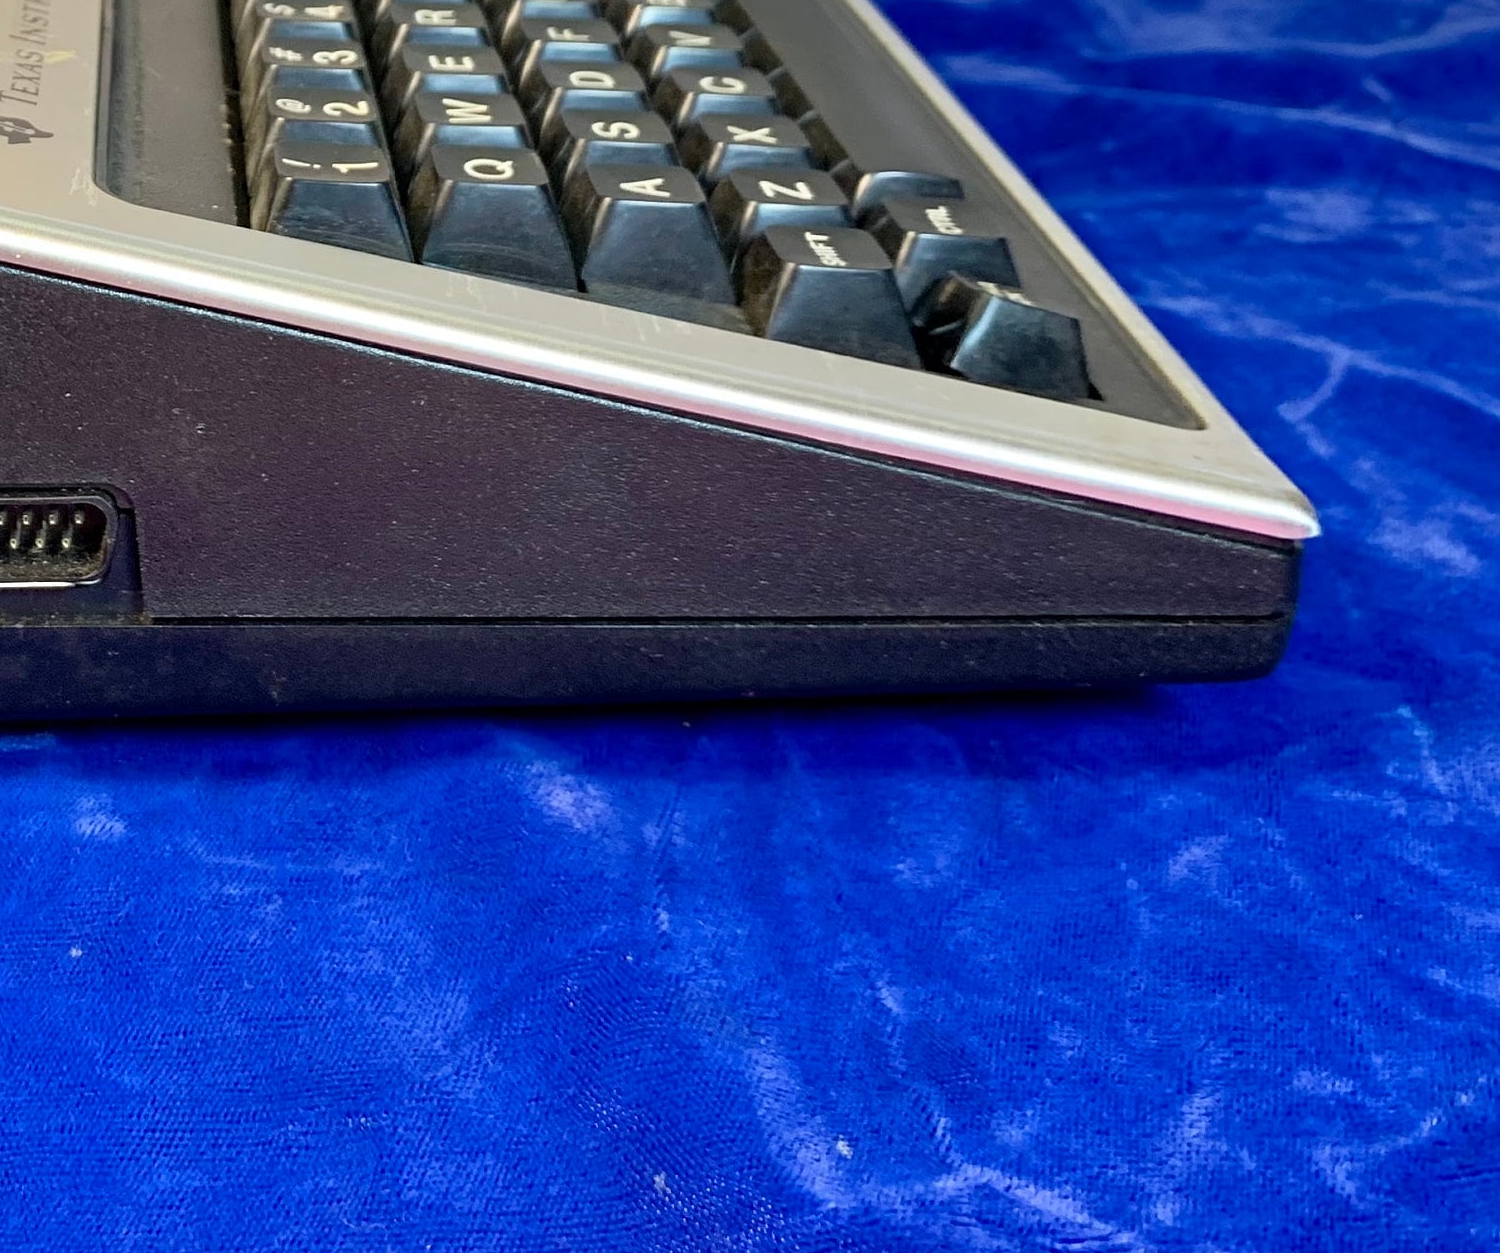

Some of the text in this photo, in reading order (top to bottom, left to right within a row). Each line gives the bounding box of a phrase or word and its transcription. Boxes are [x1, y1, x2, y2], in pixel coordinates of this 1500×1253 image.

[304, 4, 345, 19] 4
[414, 9, 457, 25] R
[547, 26, 590, 41] F
[667, 30, 712, 47] V
[312, 50, 358, 64] 3
[428, 54, 476, 72] E
[568, 70, 617, 89] D
[699, 76, 746, 94] C
[275, 98, 312, 114] @
[322, 100, 369, 116] 2
[442, 98, 492, 124] W
[591, 121, 640, 140] S
[726, 124, 778, 144] X
[282, 157, 322, 169] !
[331, 162, 380, 174] 1
[463, 158, 515, 180] Q
[619, 177, 671, 198] A
[758, 180, 815, 201] Z
[924, 205, 963, 235] CTRL
[803, 231, 848, 267] SHIFT
